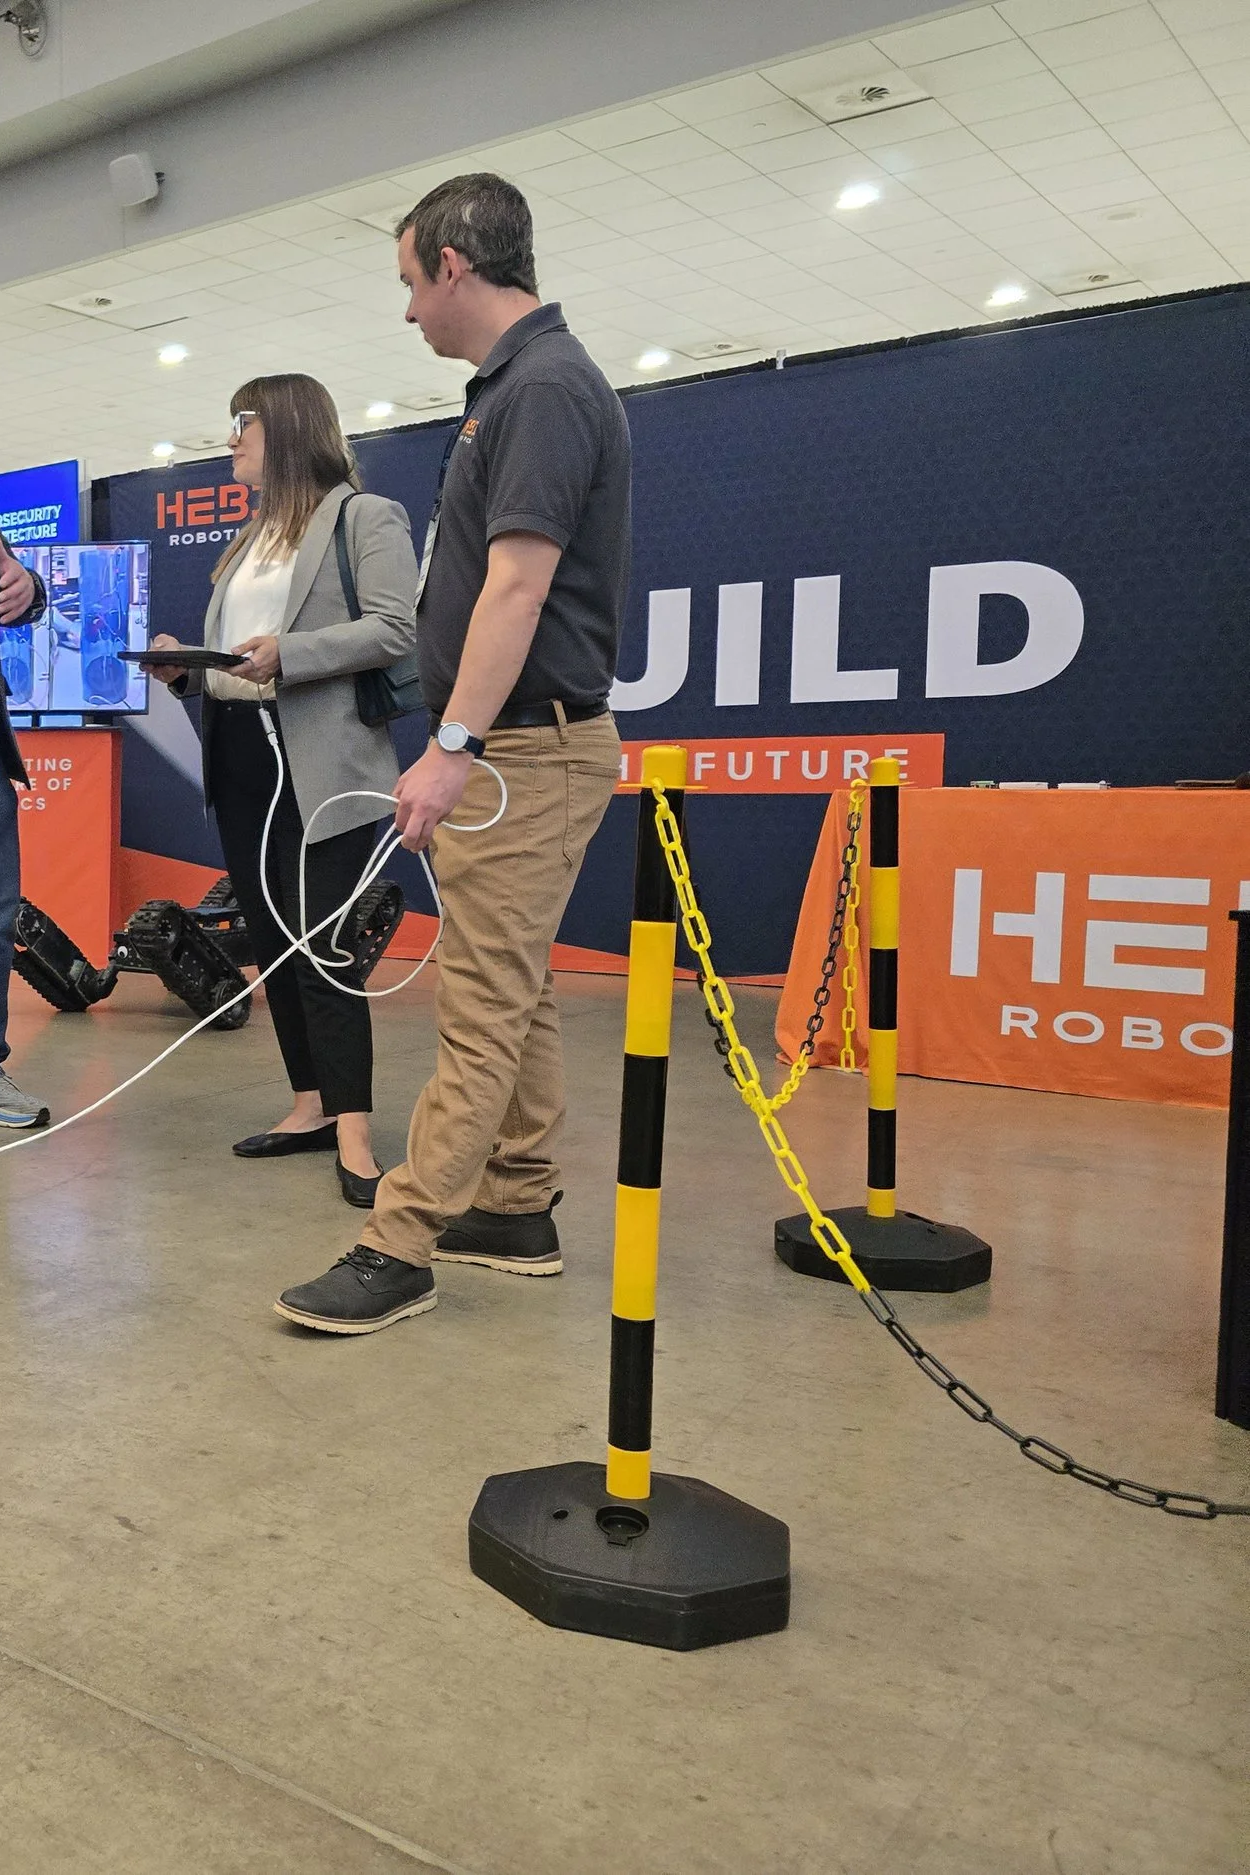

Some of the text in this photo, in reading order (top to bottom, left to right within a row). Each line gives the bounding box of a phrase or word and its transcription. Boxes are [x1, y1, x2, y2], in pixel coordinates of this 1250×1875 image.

[157, 484, 262, 529] HEB
[2, 523, 57, 543] TECTURE
[694, 749, 910, 781] FUTURE
[47, 778, 72, 791] OF
[950, 868, 1250, 995] HE
[1000, 1005, 1234, 1056] ROBO
